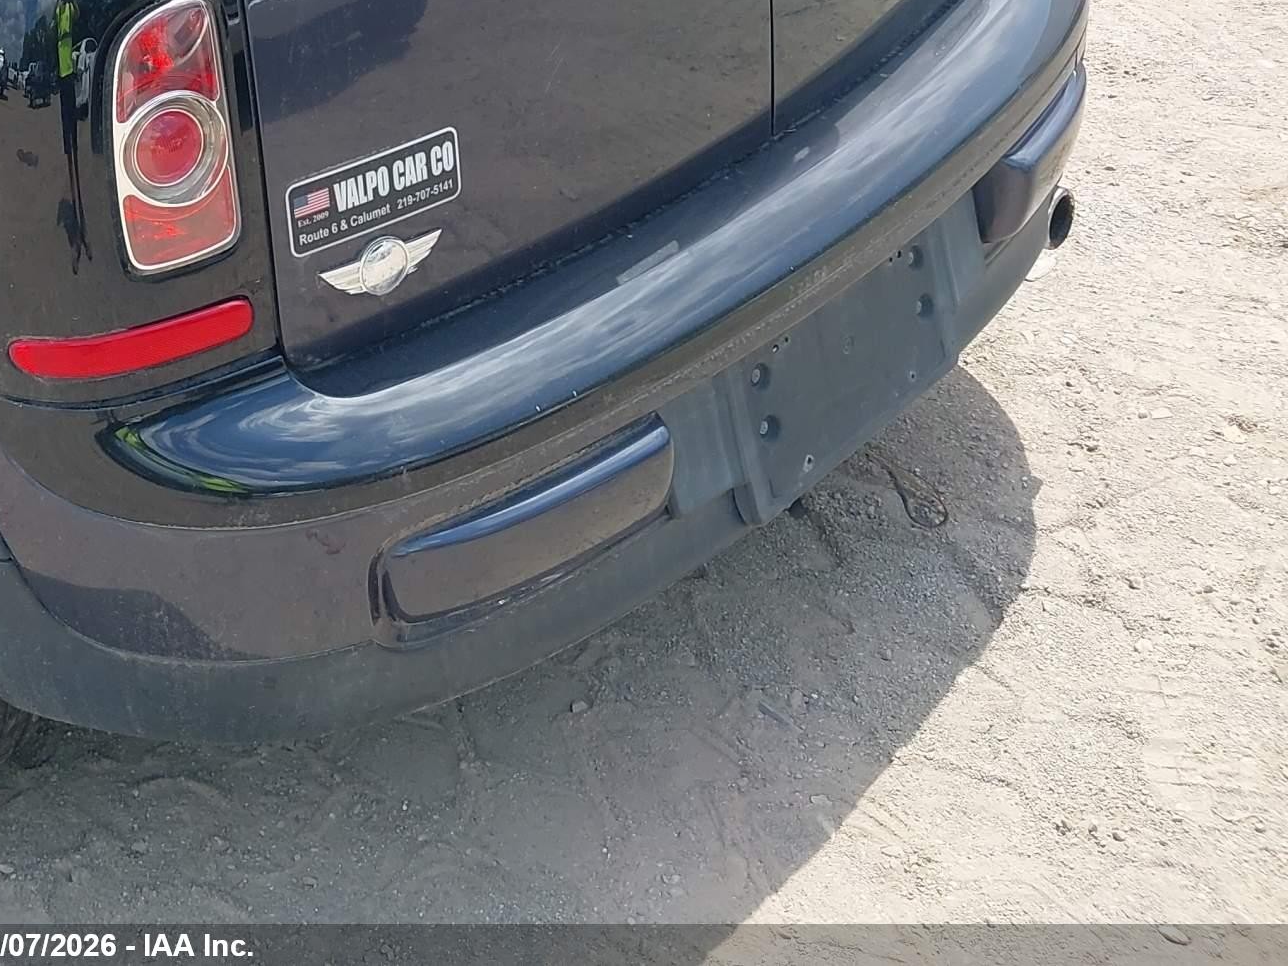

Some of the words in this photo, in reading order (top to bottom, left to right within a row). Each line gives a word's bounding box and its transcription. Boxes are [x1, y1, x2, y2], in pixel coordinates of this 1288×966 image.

[333, 166, 390, 212] VALPO
[392, 151, 429, 191] CAR
[430, 141, 454, 176] CO
[299, 227, 330, 246] Route
[331, 222, 339, 234] 6
[340, 218, 349, 231] &
[350, 203, 391, 227] Calumet
[396, 178, 453, 210] 219-707-5141
[313, 210, 330, 223] 2009
